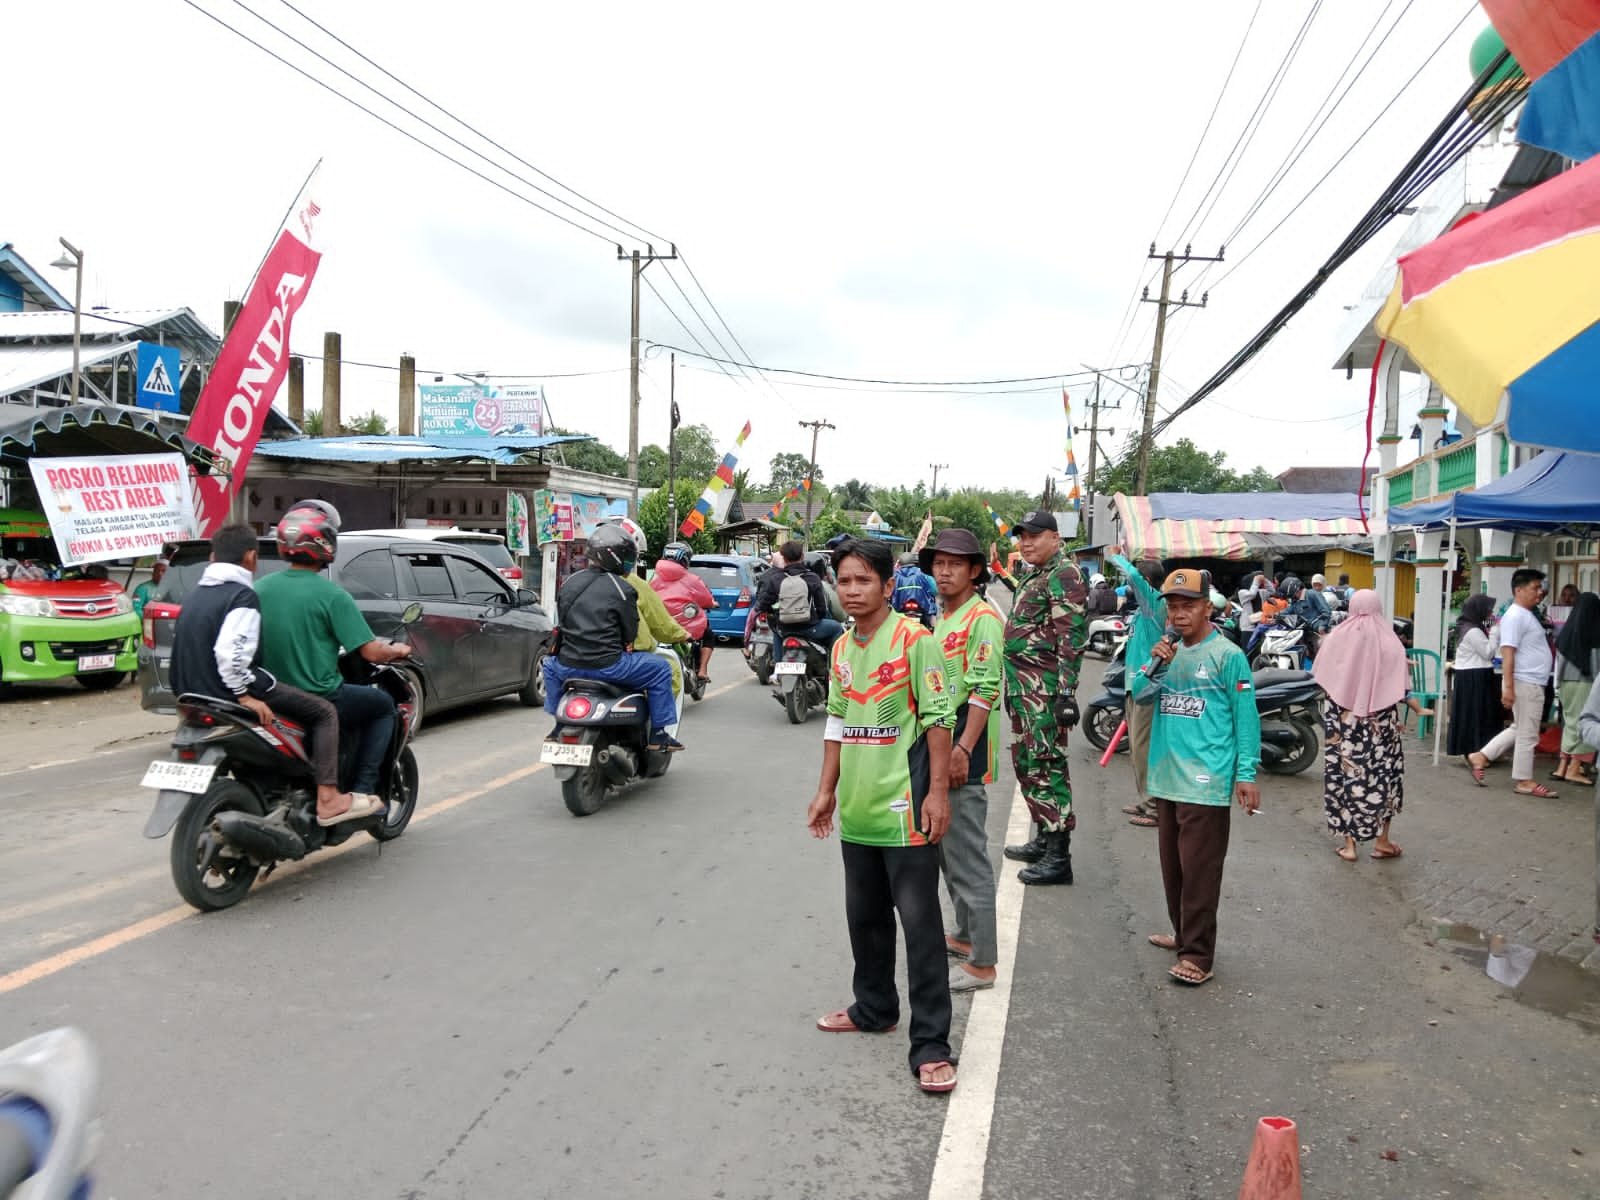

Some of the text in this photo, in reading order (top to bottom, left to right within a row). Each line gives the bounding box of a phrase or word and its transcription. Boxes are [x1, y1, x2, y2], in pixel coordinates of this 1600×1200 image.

[209, 272, 306, 493] HONDA
[422, 393, 471, 403] Makanan
[422, 406, 469, 416] Minuman
[476, 404, 497, 422] 24
[46, 464, 179, 489] POSKO RELAWAN
[82, 487, 166, 512] REST AREA
[73, 519, 103, 527] MASJID
[75, 526, 106, 536] TELAGA
[70, 540, 104, 555] RMKM
[107, 539, 114, 551] &
[114, 536, 135, 551] BPK
[135, 533, 165, 548] PUTRA
[867, 727, 900, 738] TELAGA
